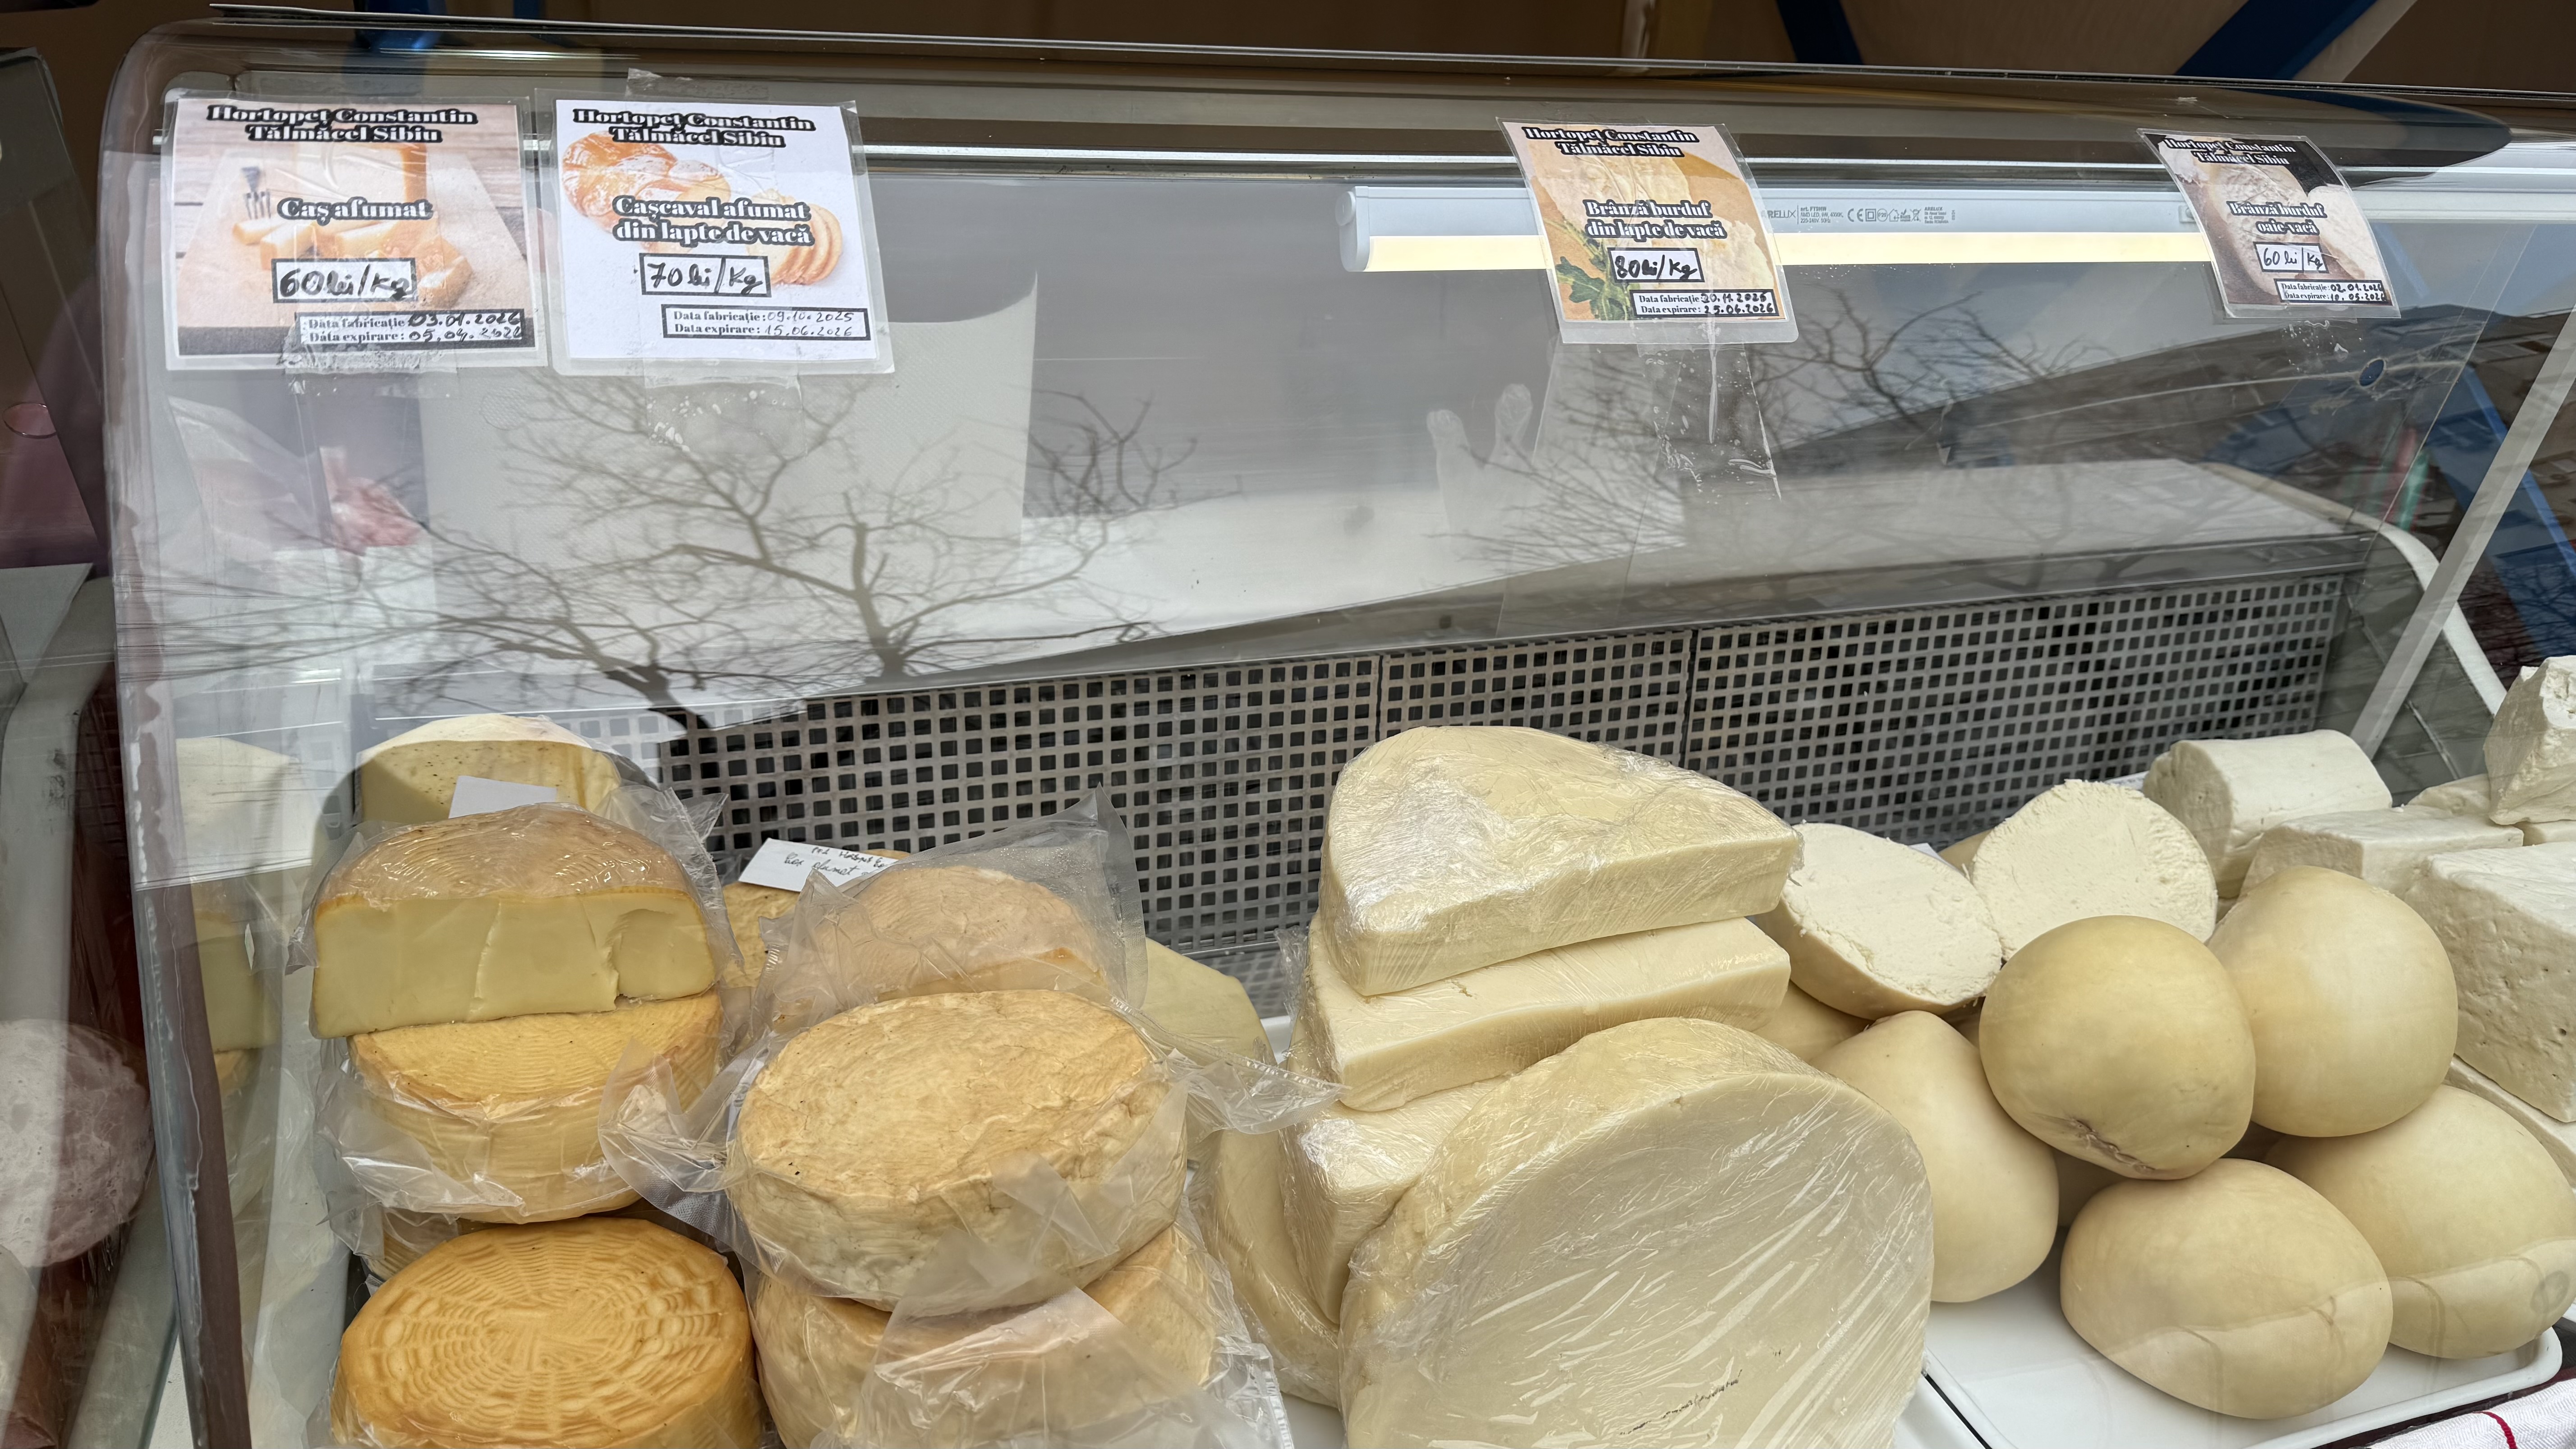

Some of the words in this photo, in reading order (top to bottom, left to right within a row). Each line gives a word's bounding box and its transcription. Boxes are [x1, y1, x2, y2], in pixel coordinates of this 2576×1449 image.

[335, 108, 478, 124] Constantin
[686, 114, 815, 130] Constantin
[247, 125, 367, 141] Tălmăcel
[373, 125, 440, 142] Sibiu
[611, 128, 719, 144] Tălmăcel
[723, 130, 784, 147] Sibiu
[1604, 129, 1698, 142] Constantin
[1556, 142, 1636, 155] Tălmăcel
[1638, 143, 1684, 157] Sibiu
[2225, 141, 2296, 152] Constantin
[2254, 154, 2290, 165] Sibiu
[279, 198, 330, 224] Caș
[334, 197, 434, 220] afumat
[615, 197, 719, 220] Cașcaval
[723, 198, 810, 220] afumat
[1585, 200, 1650, 216] Brânză
[1650, 200, 1712, 217] burduf
[2227, 202, 2279, 215] Brânză
[2278, 202, 2326, 217] burduf
[615, 220, 656, 240] din
[661, 221, 722, 246] lapte
[725, 223, 755, 243] de
[758, 226, 812, 244] vacă
[1586, 220, 1616, 237] din
[1616, 220, 1661, 241] lapte
[1663, 220, 1687, 237] de
[1687, 221, 1726, 238] vacă
[2263, 248, 2280, 266] 60
[647, 262, 683, 288] 70
[2300, 293, 2329, 301] expirare:
[674, 311, 701, 320] Data
[1662, 306, 1701, 314] expirare:
[308, 319, 339, 329] Data
[675, 324, 703, 332] Data
[704, 324, 760, 335] expirare:
[309, 330, 340, 341] Data
[342, 331, 405, 345] expirare:
